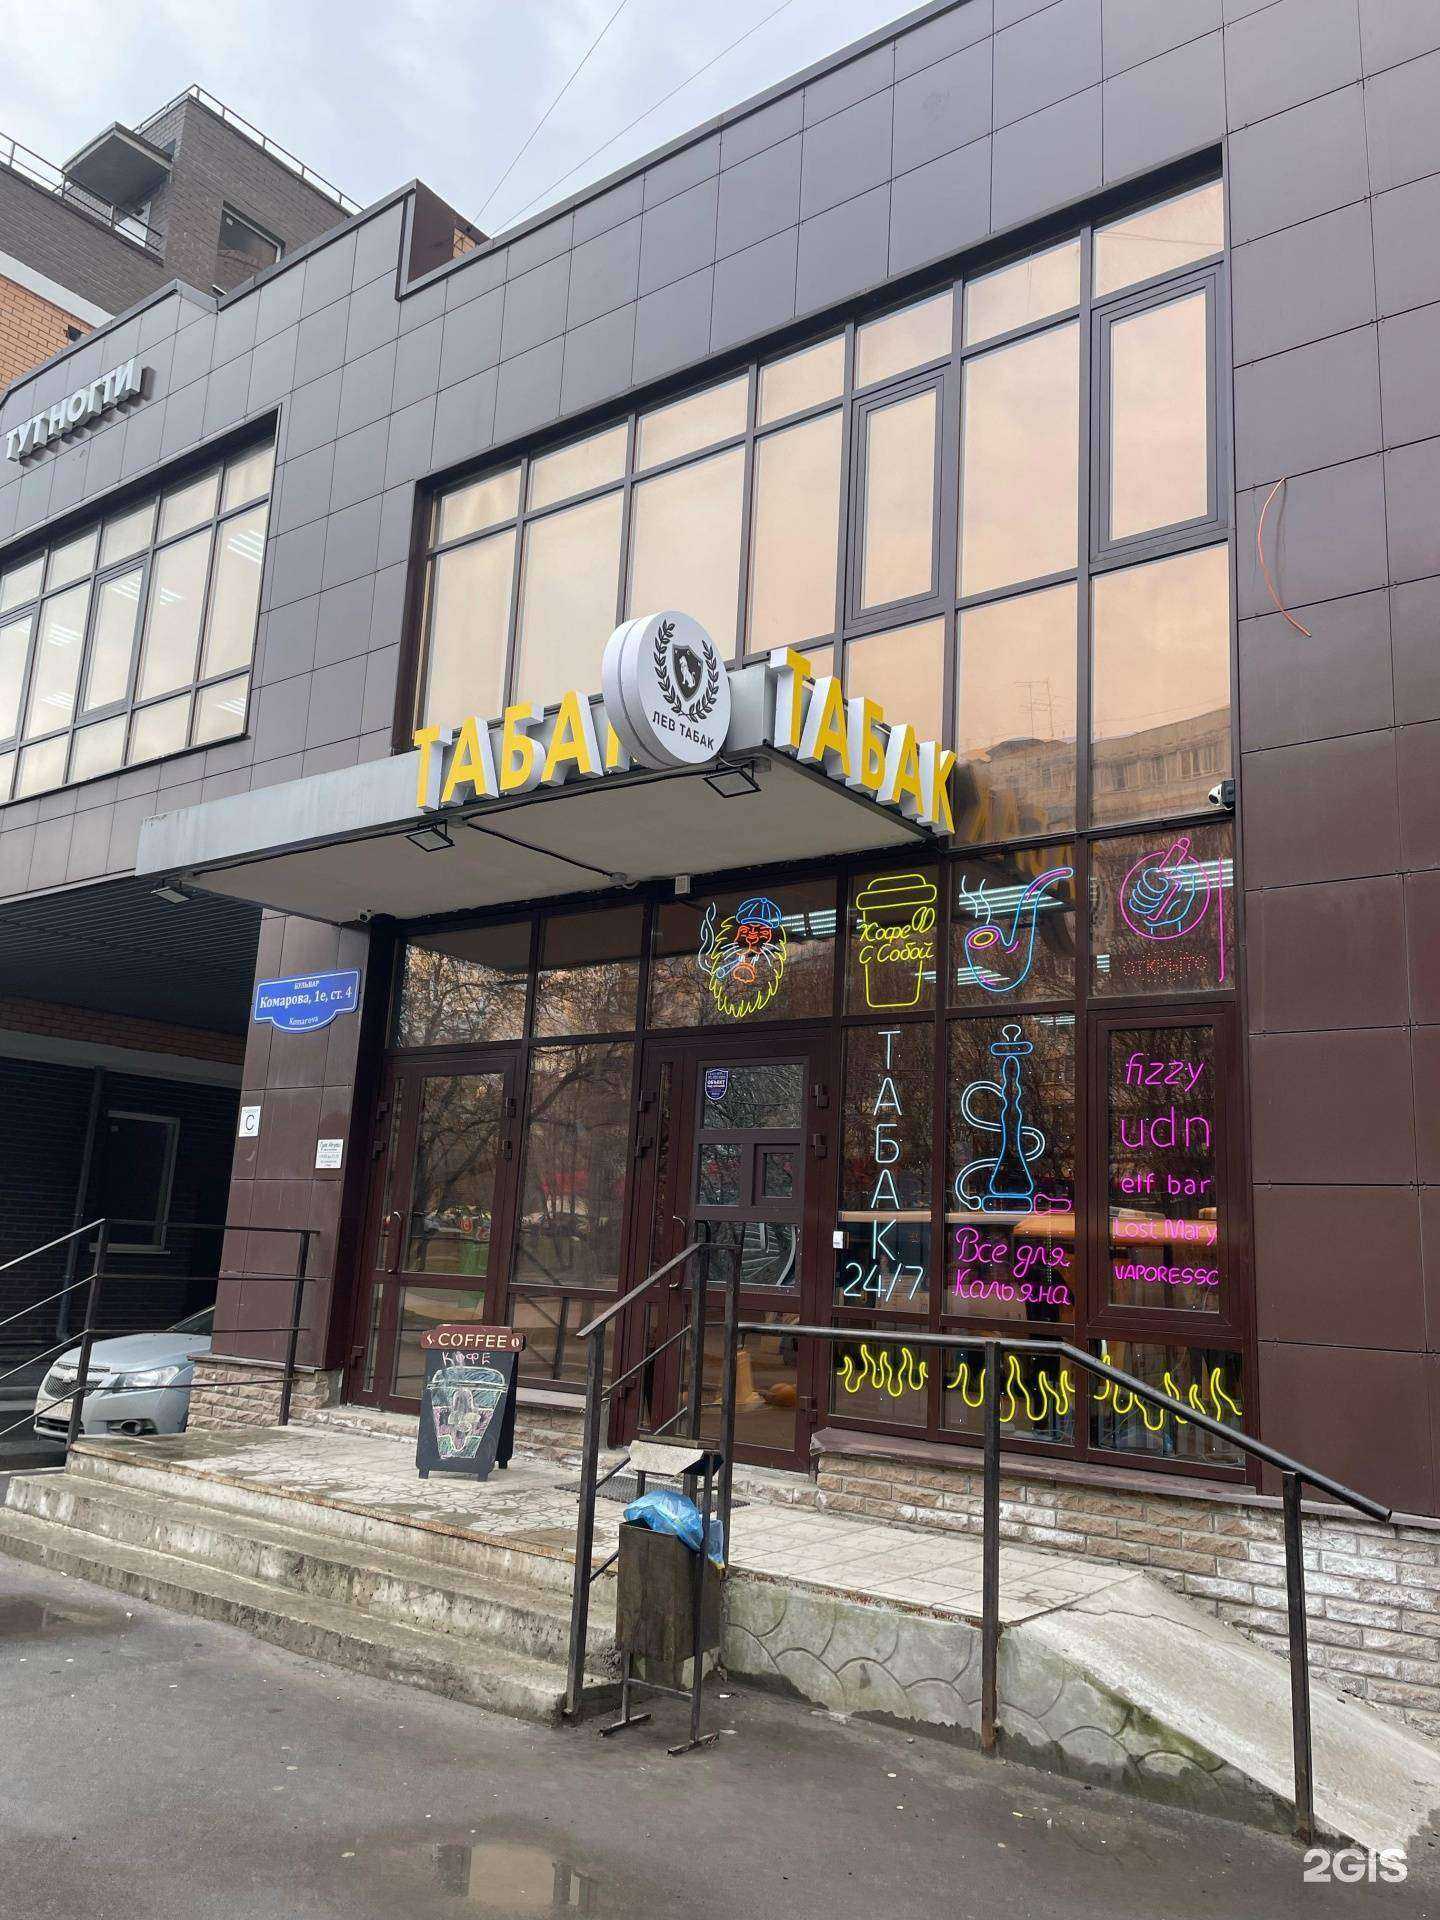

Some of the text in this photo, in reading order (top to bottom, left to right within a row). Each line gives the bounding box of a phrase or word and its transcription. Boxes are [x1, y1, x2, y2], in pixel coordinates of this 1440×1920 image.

[652, 711, 715, 751] ЛЕВ ТАБАК
[772, 647, 957, 835] ТАБАК
[858, 922, 911, 946] Кофе
[877, 941, 935, 963] Собой
[259, 994, 312, 1009] Комарова,
[330, 990, 343, 1000] ст.
[345, 985, 353, 998] 4
[1125, 1052, 1205, 1092] fizzy
[871, 1031, 902, 1260] ТАБАК
[1121, 1105, 1210, 1148] udn
[1121, 1173, 1212, 1195] elf bar
[955, 1225, 1071, 1278] Все для
[1112, 1218, 1218, 1247] Lost Mary
[843, 1262, 924, 1302] 24/7
[952, 1267, 1072, 1306] Кальяна
[437, 1332, 508, 1348] COFFEE
